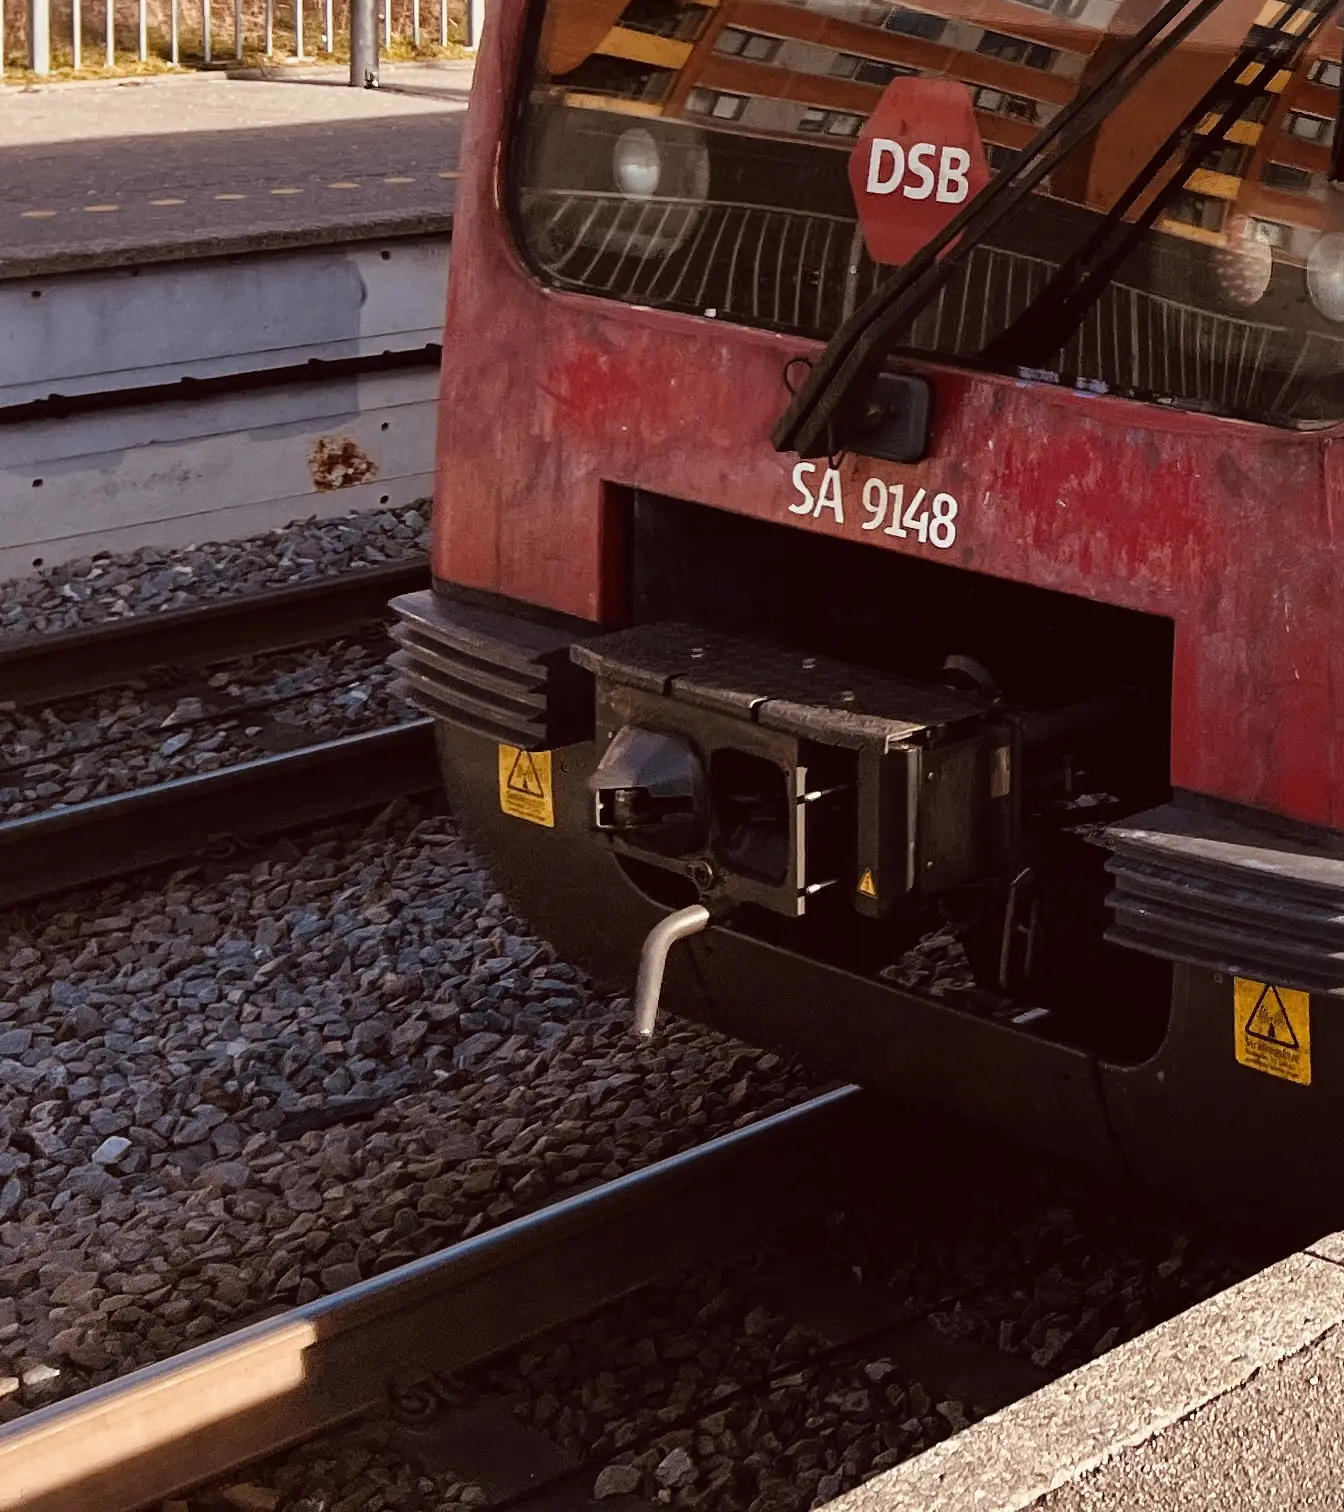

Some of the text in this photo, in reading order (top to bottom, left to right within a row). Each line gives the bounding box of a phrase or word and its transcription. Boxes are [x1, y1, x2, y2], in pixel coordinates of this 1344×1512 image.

[866, 137, 971, 204] DSB
[788, 461, 959, 550] SA 9148
